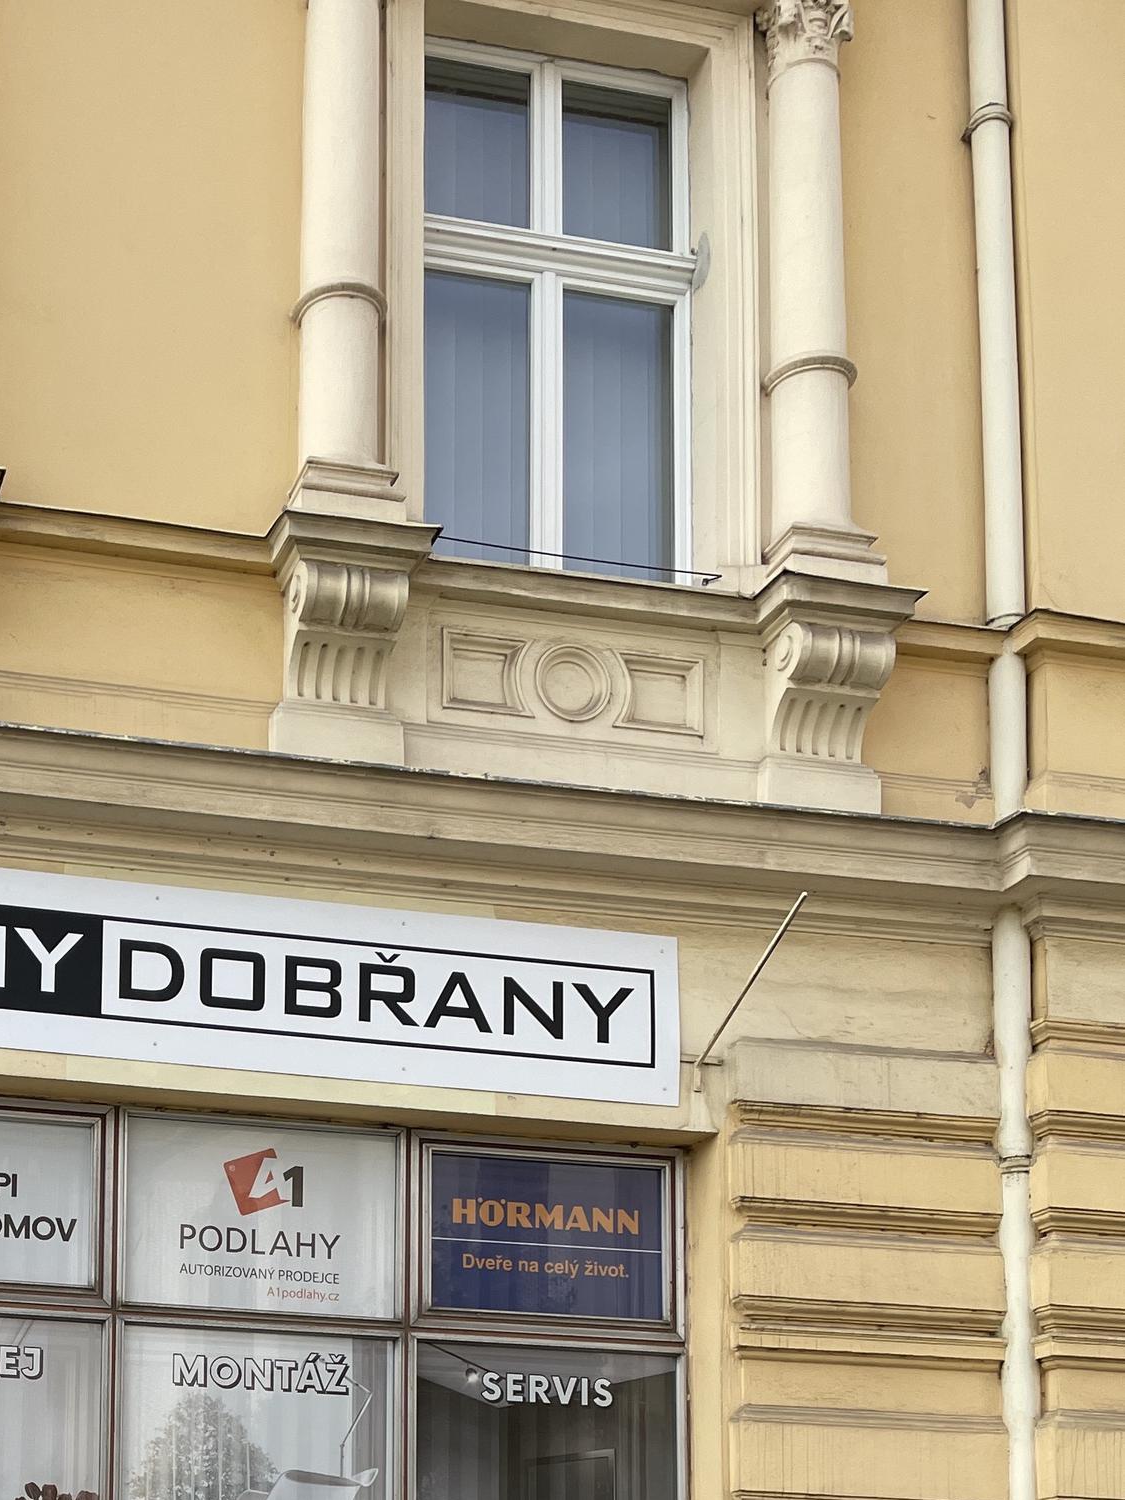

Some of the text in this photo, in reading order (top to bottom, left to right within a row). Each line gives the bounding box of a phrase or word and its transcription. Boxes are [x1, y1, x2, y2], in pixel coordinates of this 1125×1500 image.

[118, 951, 634, 1043] DOBŘANY
[452, 1196, 639, 1235] HÖRMANN
[179, 1223, 341, 1259] PODLAHY
[179, 1263, 340, 1284] AUTORIZOVANÝ PRODEJCE
[462, 1254, 629, 1279] Dveře na celý život.
[267, 1287, 340, 1302] A1podlahy.cz
[172, 1352, 349, 1395] MONTÁŽ
[481, 1371, 614, 1408] SERVIS
